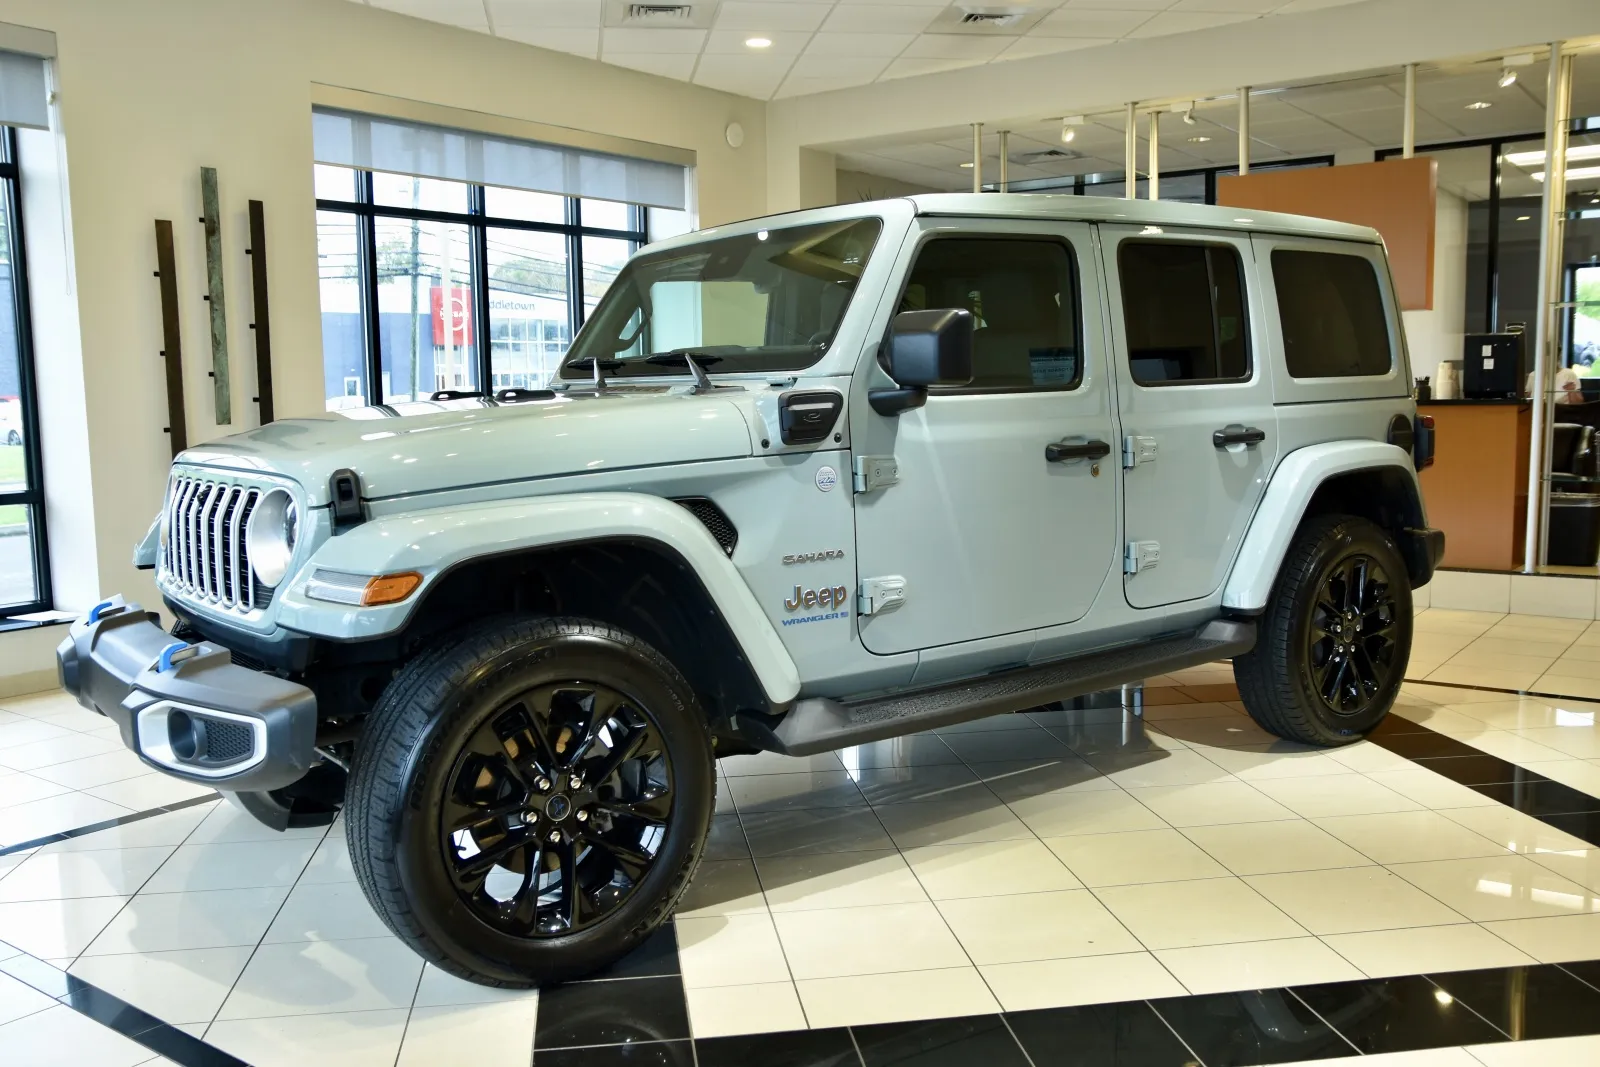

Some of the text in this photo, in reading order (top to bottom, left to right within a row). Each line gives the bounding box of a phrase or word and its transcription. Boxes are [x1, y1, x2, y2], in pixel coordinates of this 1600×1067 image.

[489, 299, 535, 311] ddletown
[783, 550, 845, 566] SAHARA
[784, 584, 847, 612] Jeep
[782, 612, 839, 626] WRANGLER
